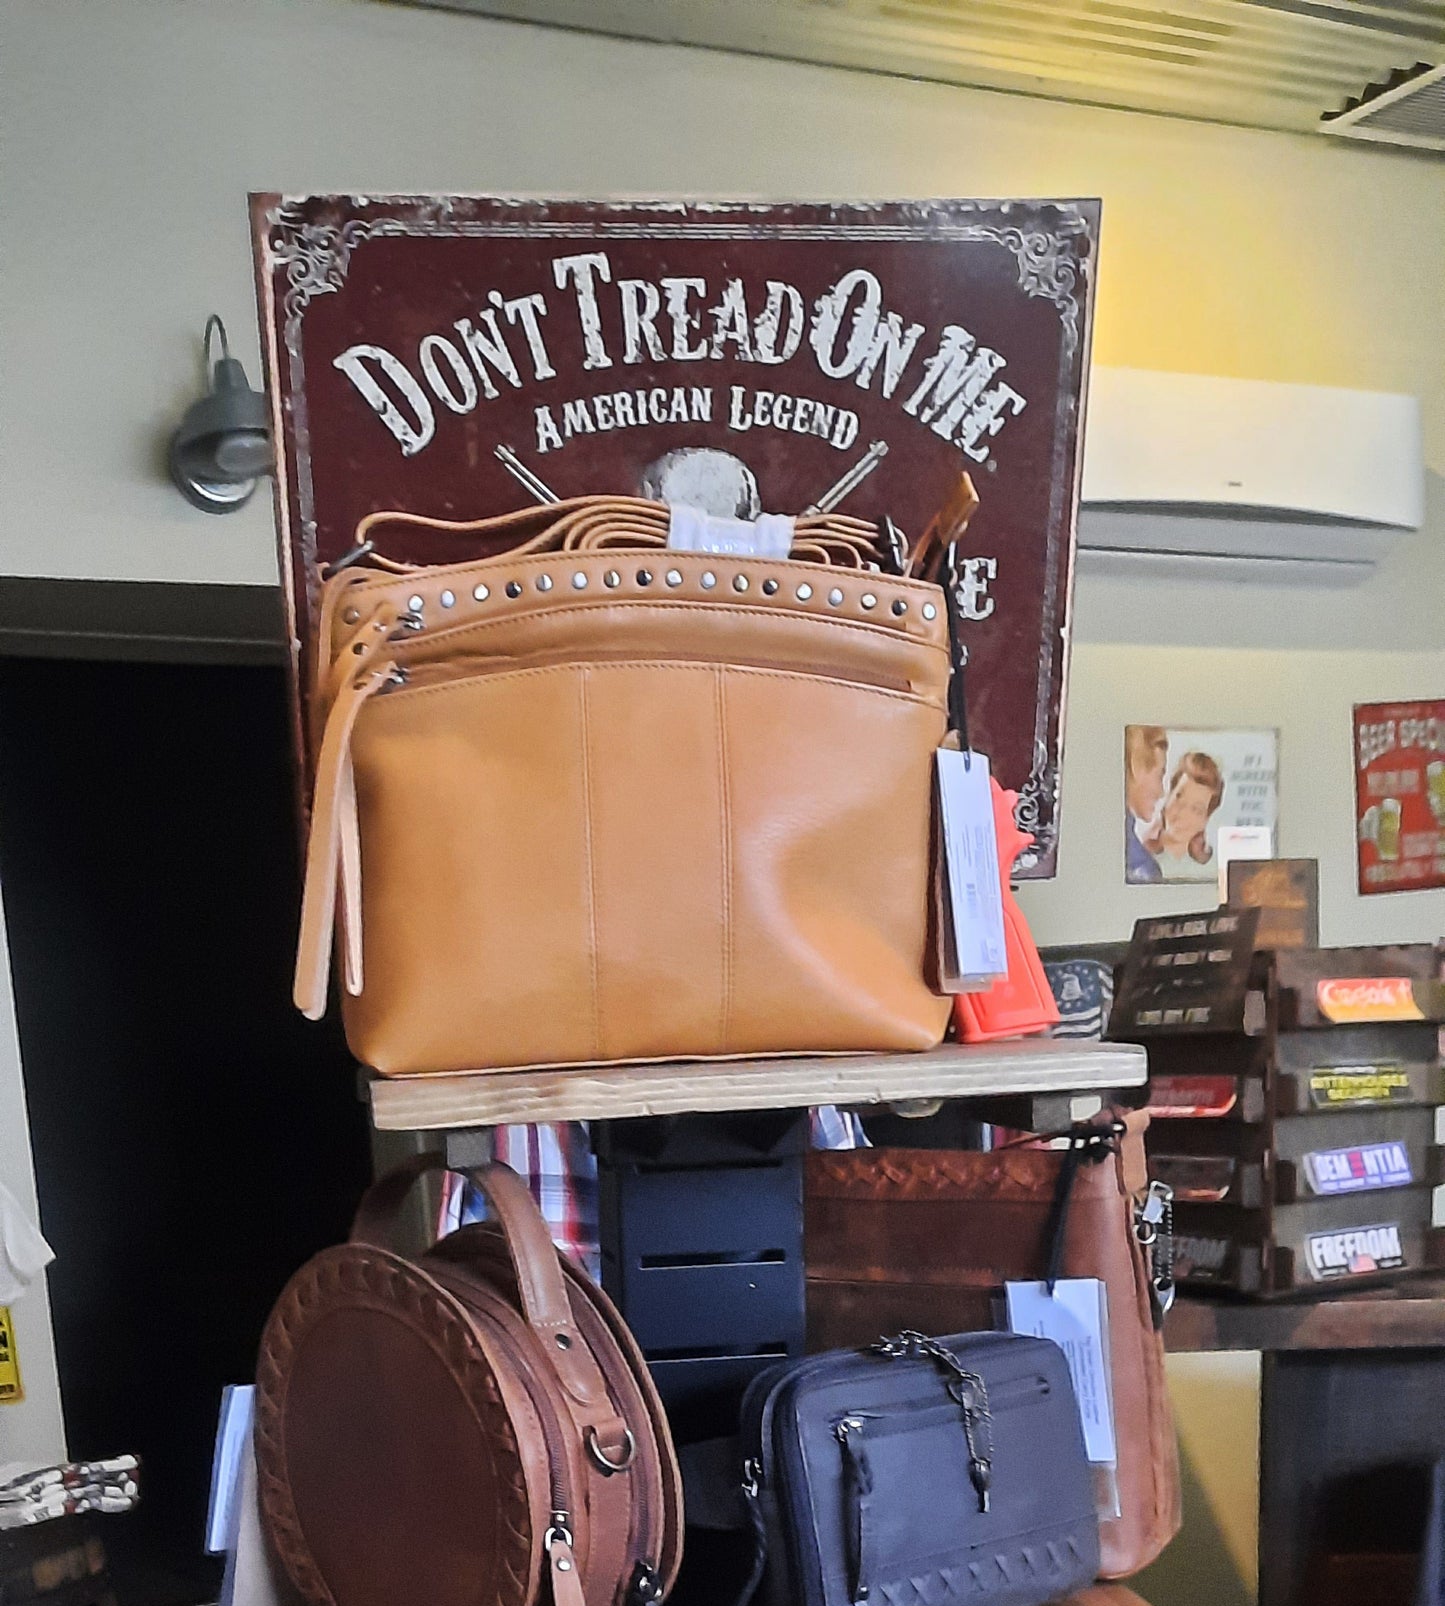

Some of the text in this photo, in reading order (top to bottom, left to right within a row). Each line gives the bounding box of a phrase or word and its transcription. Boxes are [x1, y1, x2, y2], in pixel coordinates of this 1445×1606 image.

[333, 289, 556, 458] DON'T
[553, 252, 804, 373] TREAD
[809, 269, 925, 398] ON
[534, 383, 860, 455] AMERICAN LEGEND
[1360, 721, 1396, 770] BEER
[1311, 1227, 1403, 1269] FREEDOM
